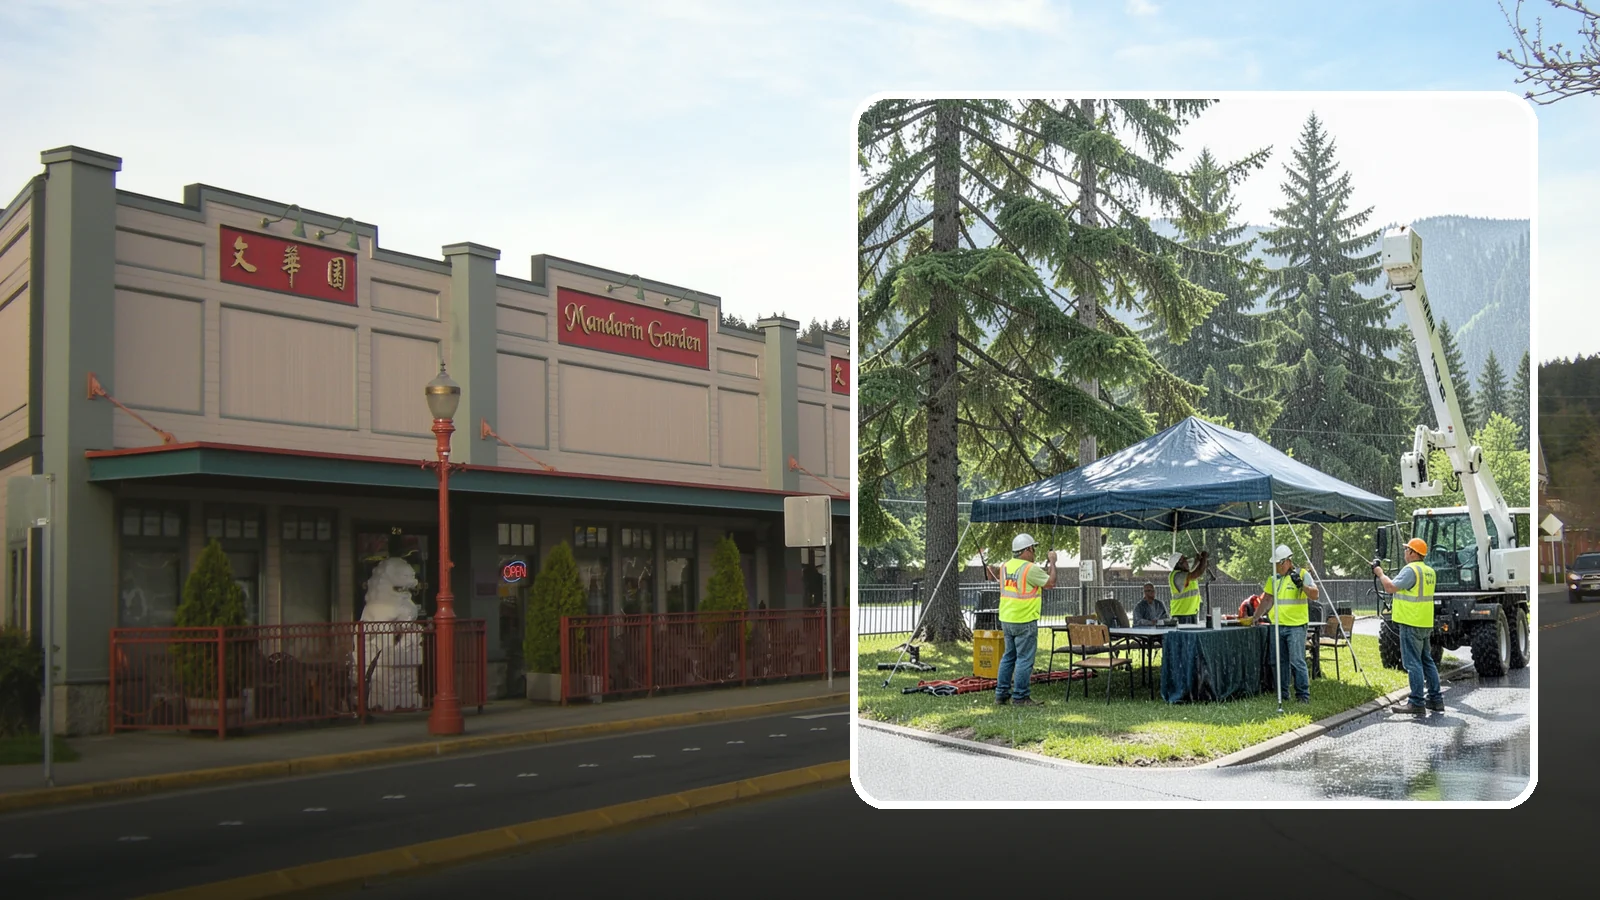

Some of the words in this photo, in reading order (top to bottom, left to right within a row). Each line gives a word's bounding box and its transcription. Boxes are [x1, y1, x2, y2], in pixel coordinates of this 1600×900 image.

[230, 235, 346, 291] 文華園
[564, 302, 644, 341] Mandarin
[648, 320, 701, 352] Garden
[503, 565, 527, 578] OPEN
